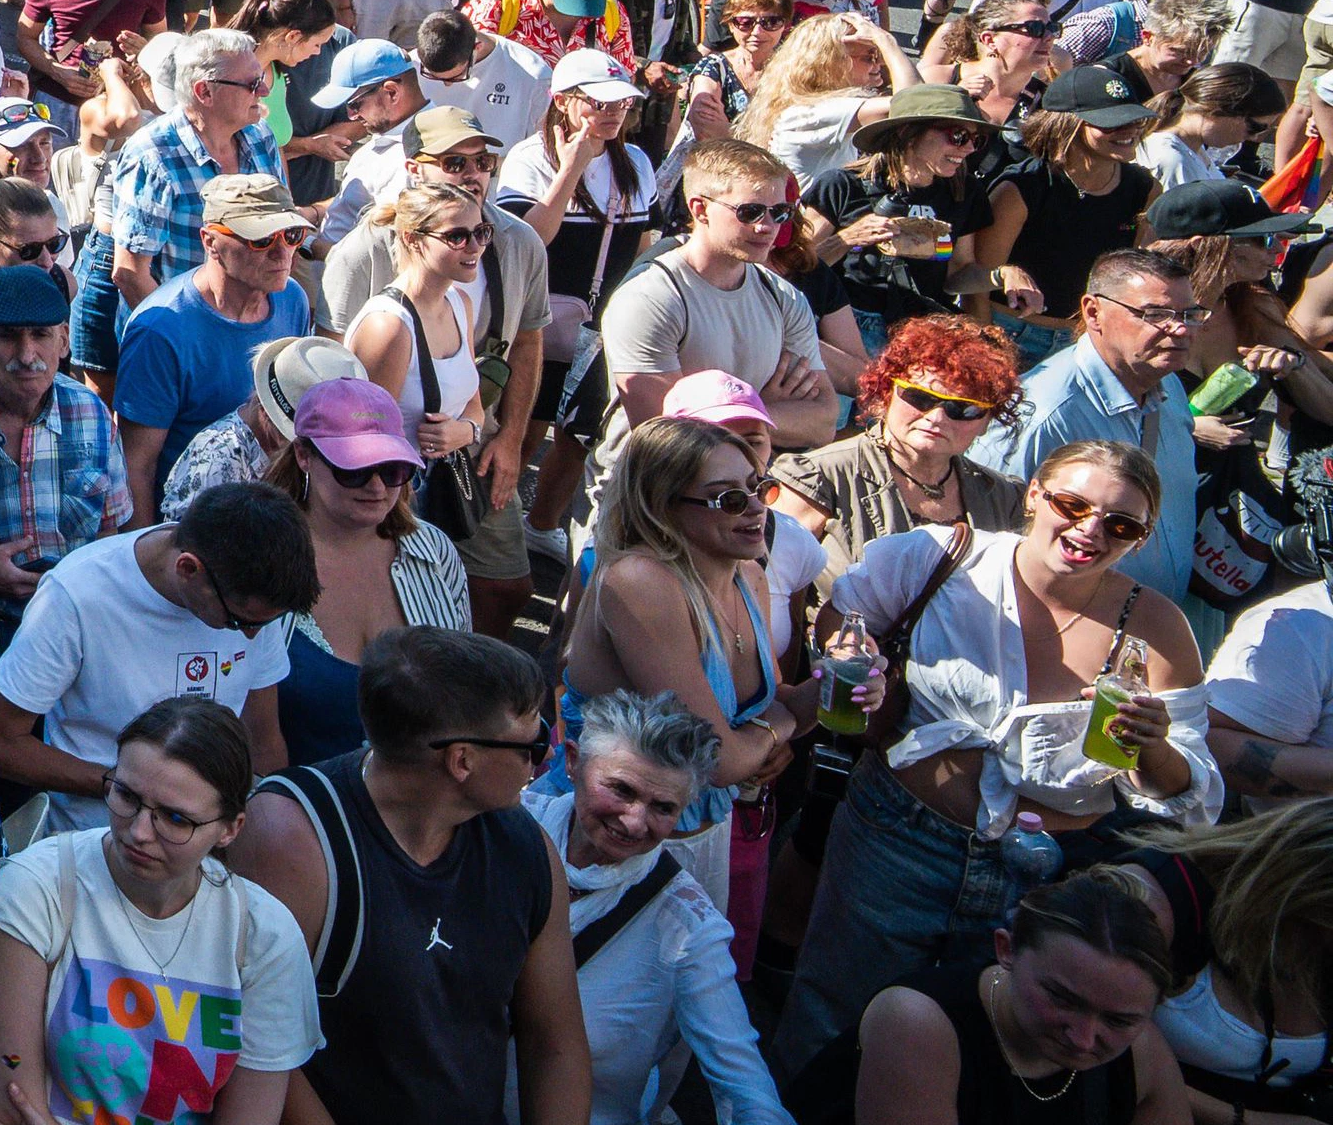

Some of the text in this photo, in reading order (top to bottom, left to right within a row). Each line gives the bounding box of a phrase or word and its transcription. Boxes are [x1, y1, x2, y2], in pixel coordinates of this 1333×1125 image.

[487, 94, 510, 105] GTI
[908, 204, 936, 219] AR
[72, 968, 243, 1050] LOVE
